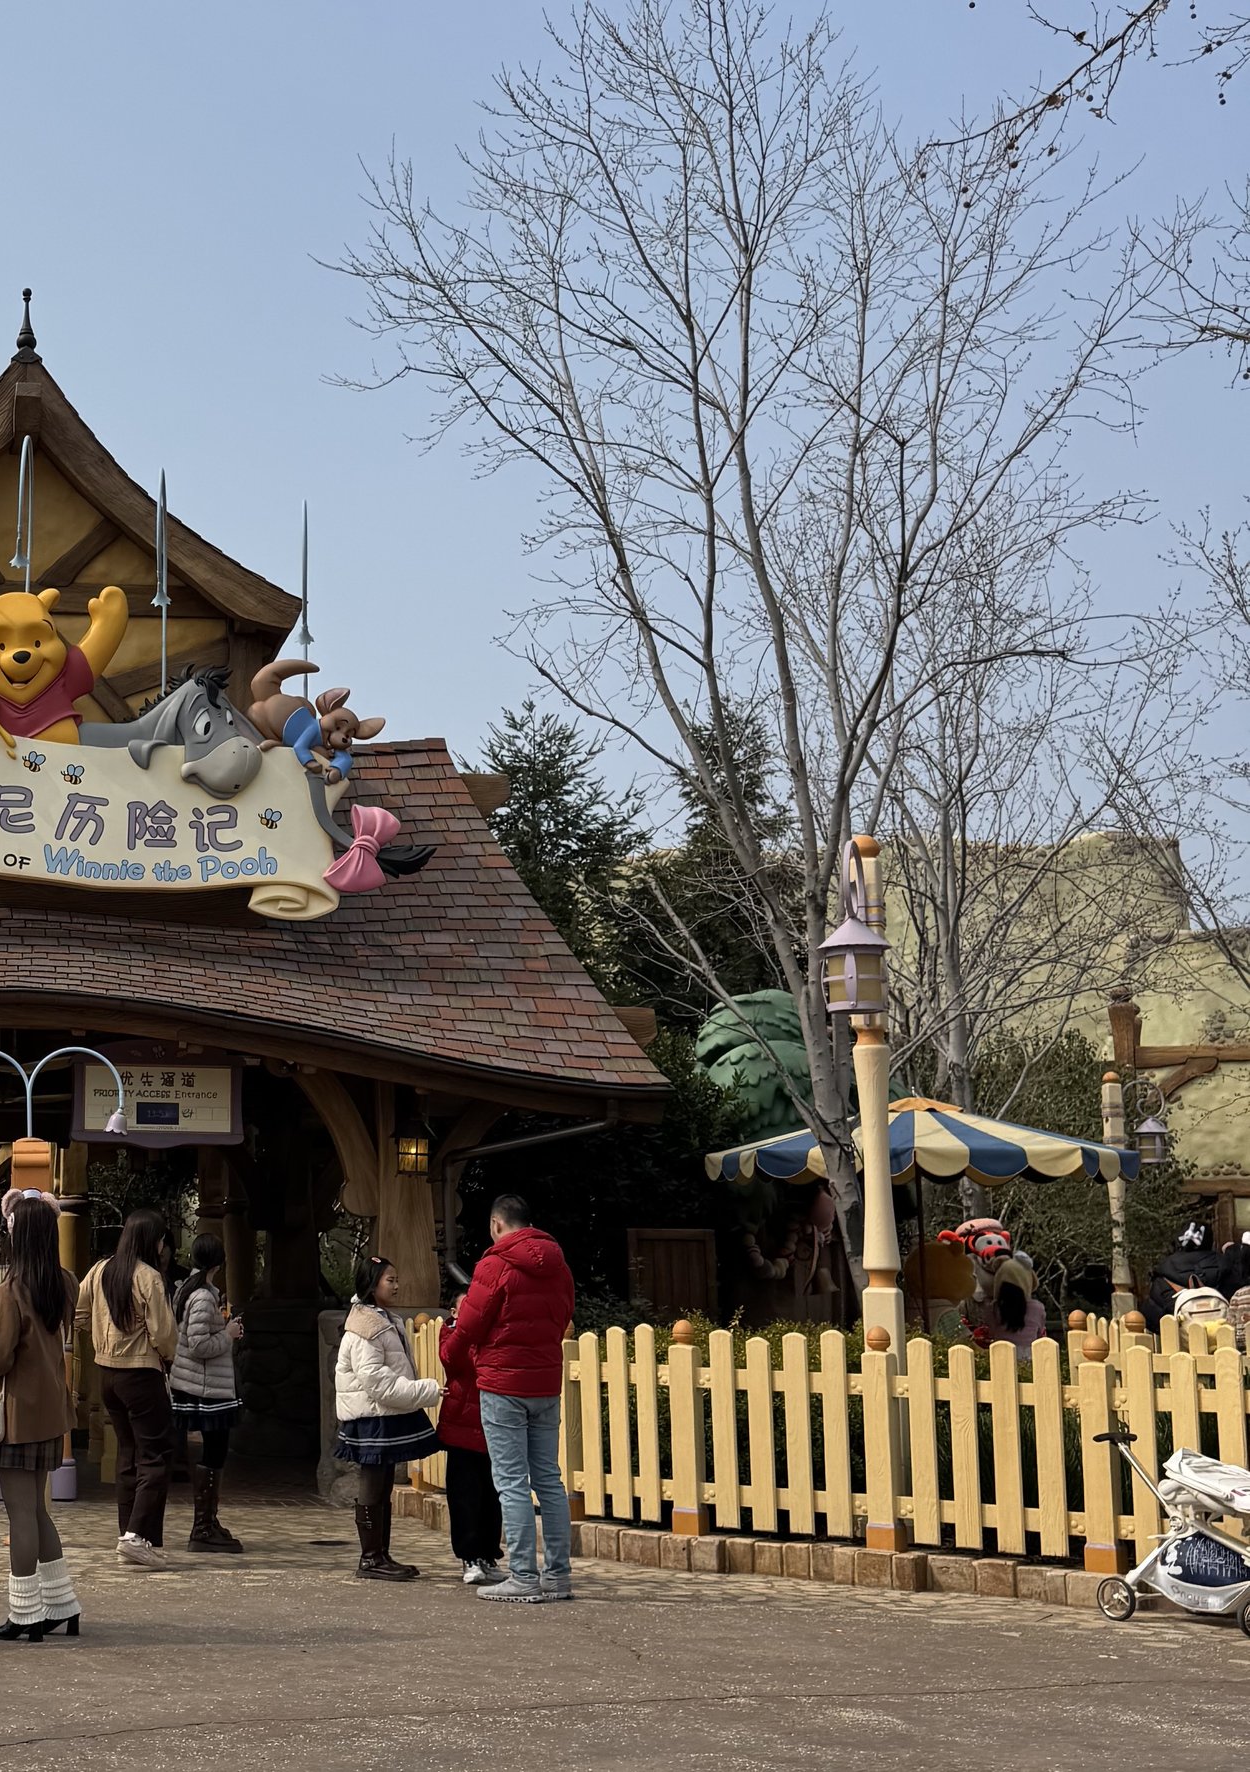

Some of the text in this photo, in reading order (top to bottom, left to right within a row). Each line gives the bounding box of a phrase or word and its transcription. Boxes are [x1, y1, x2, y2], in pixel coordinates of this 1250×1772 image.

[2, 853, 32, 870] OF
[43, 843, 146, 881] Winnie
[152, 860, 192, 882] the
[196, 846, 279, 883] Pooh
[120, 1070, 197, 1088] 优先通道
[93, 1088, 218, 1099] PRIORTY ACCESS Entrance
